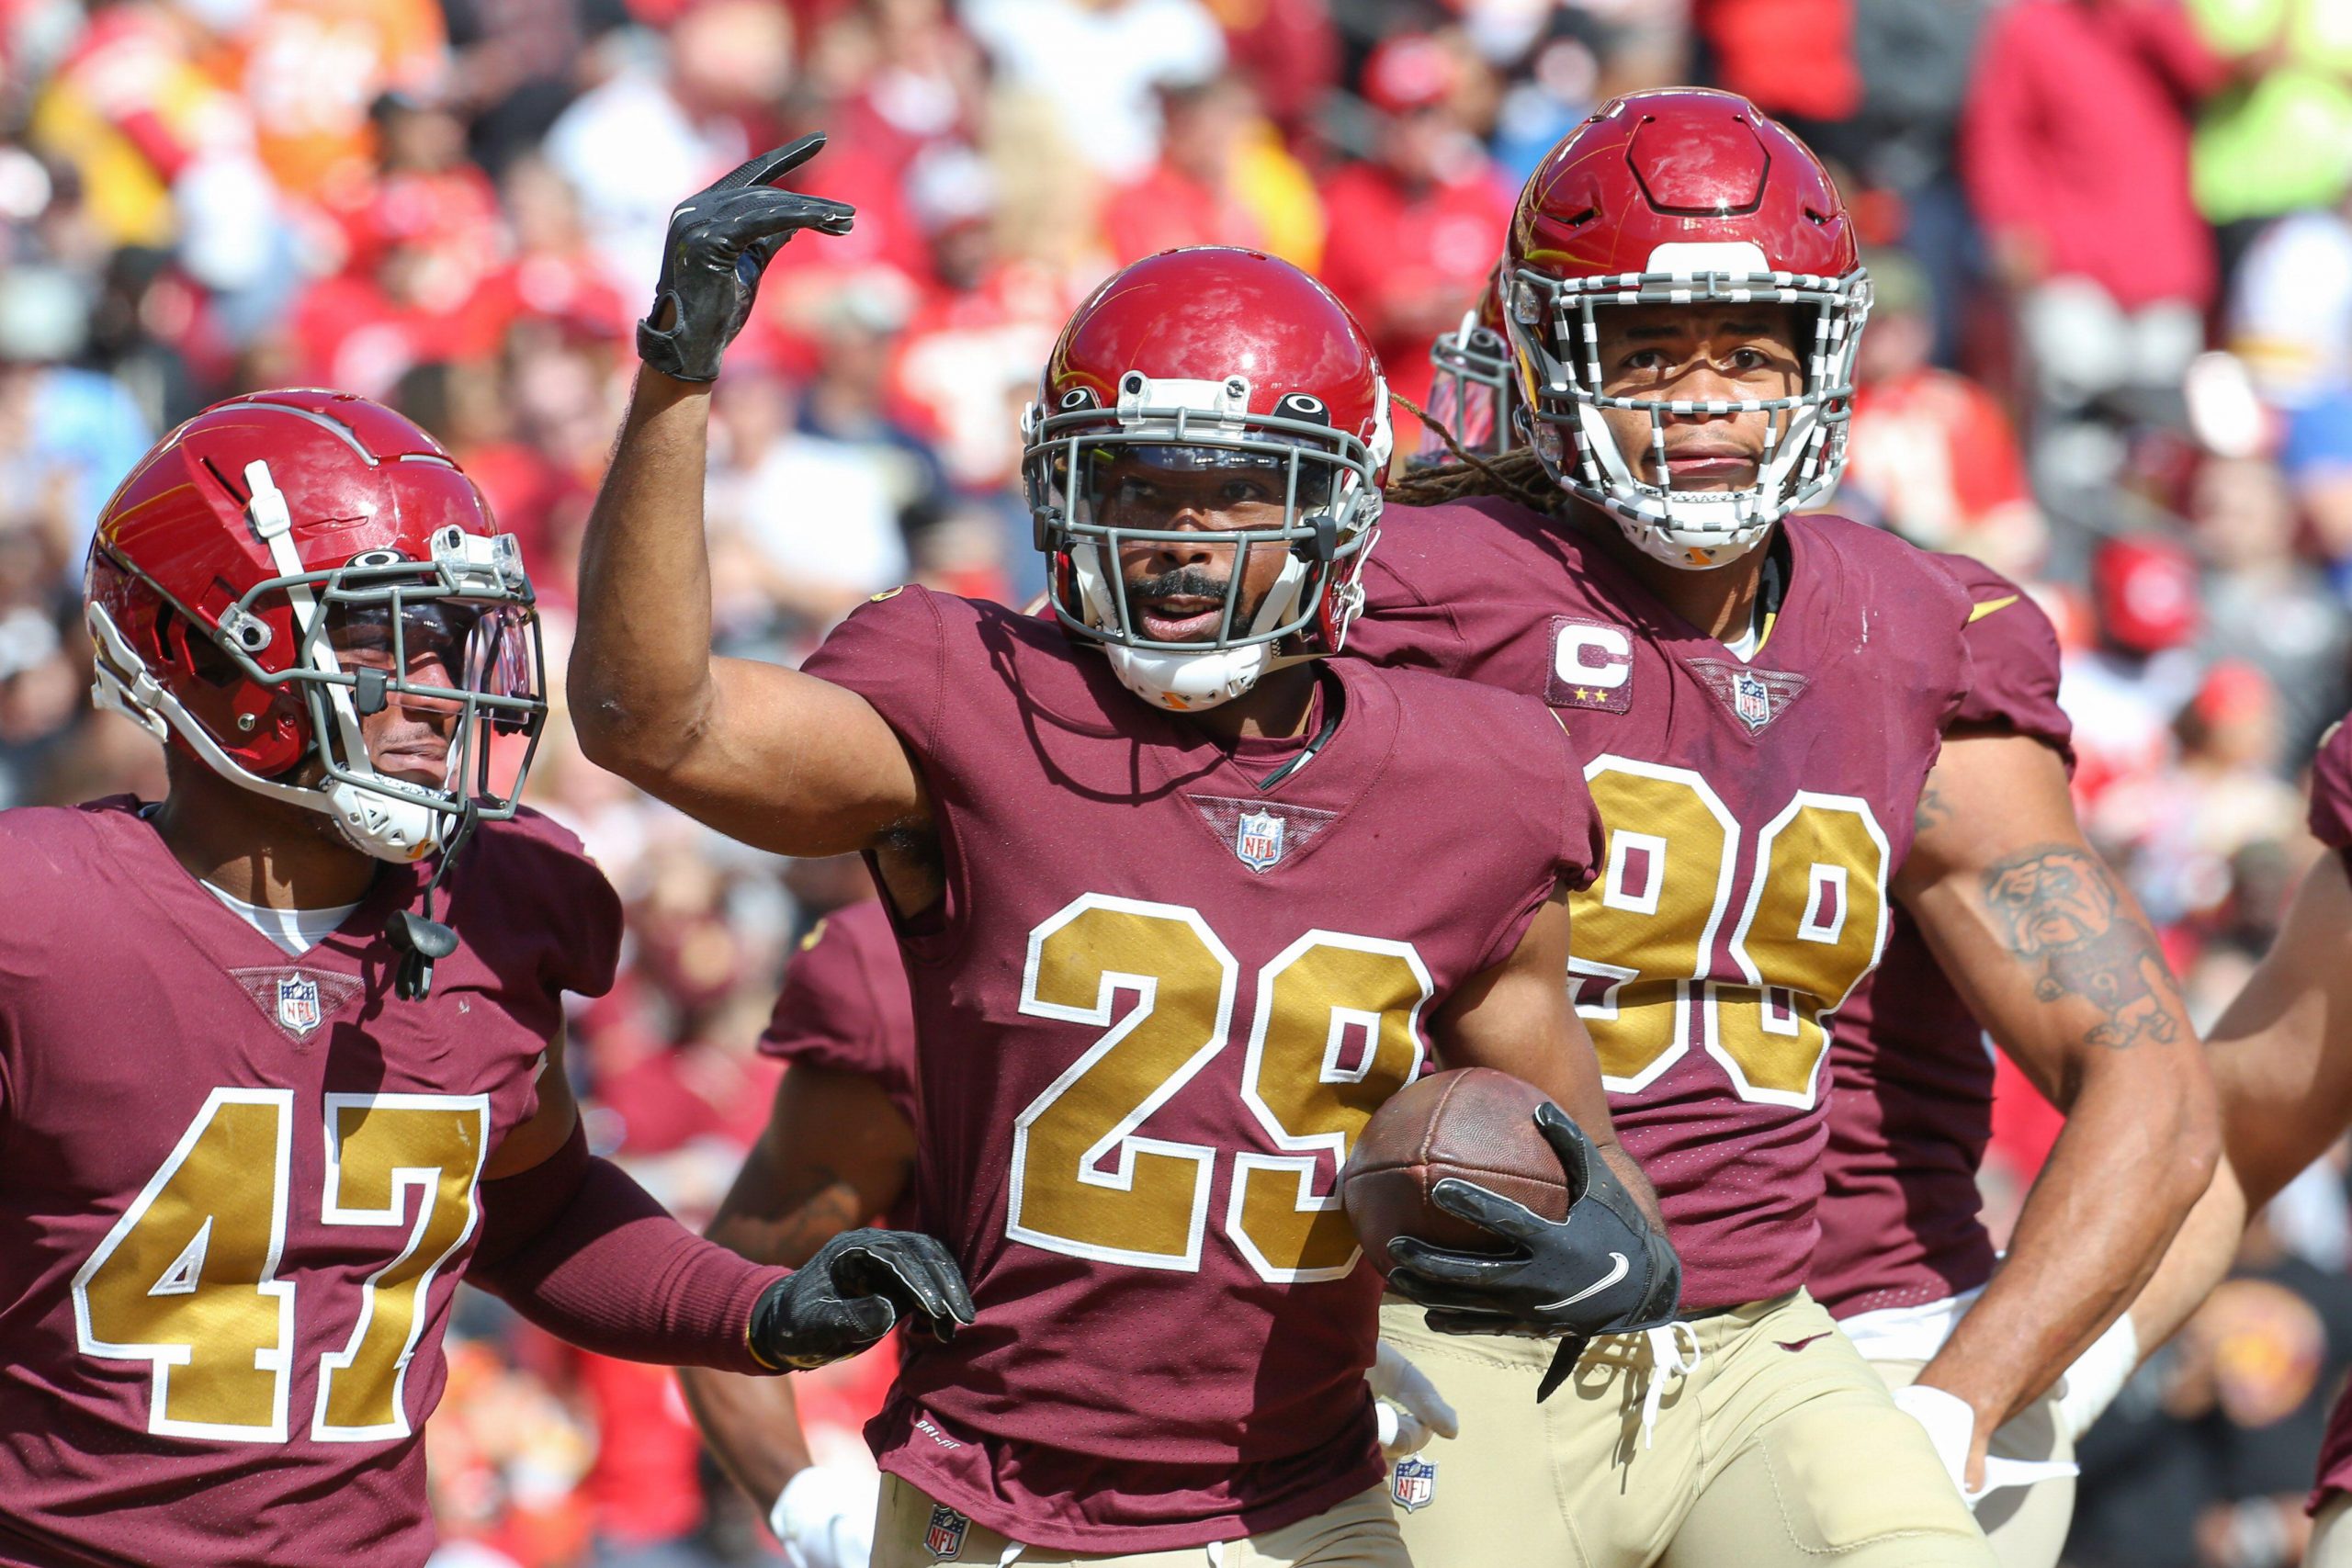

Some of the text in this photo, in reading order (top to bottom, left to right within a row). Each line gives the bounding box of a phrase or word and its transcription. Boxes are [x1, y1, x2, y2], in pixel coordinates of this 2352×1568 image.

[1555, 624, 1632, 687] C
[1244, 836, 1275, 860] NFL
[285, 1000, 316, 1021] NFL
[1005, 892, 1435, 1283] 29
[71, 1087, 490, 1443] 47
[915, 1420, 961, 1449] DRI-FIT
[1397, 1478, 1427, 1501] NFL
[928, 1527, 956, 1552] NFL
